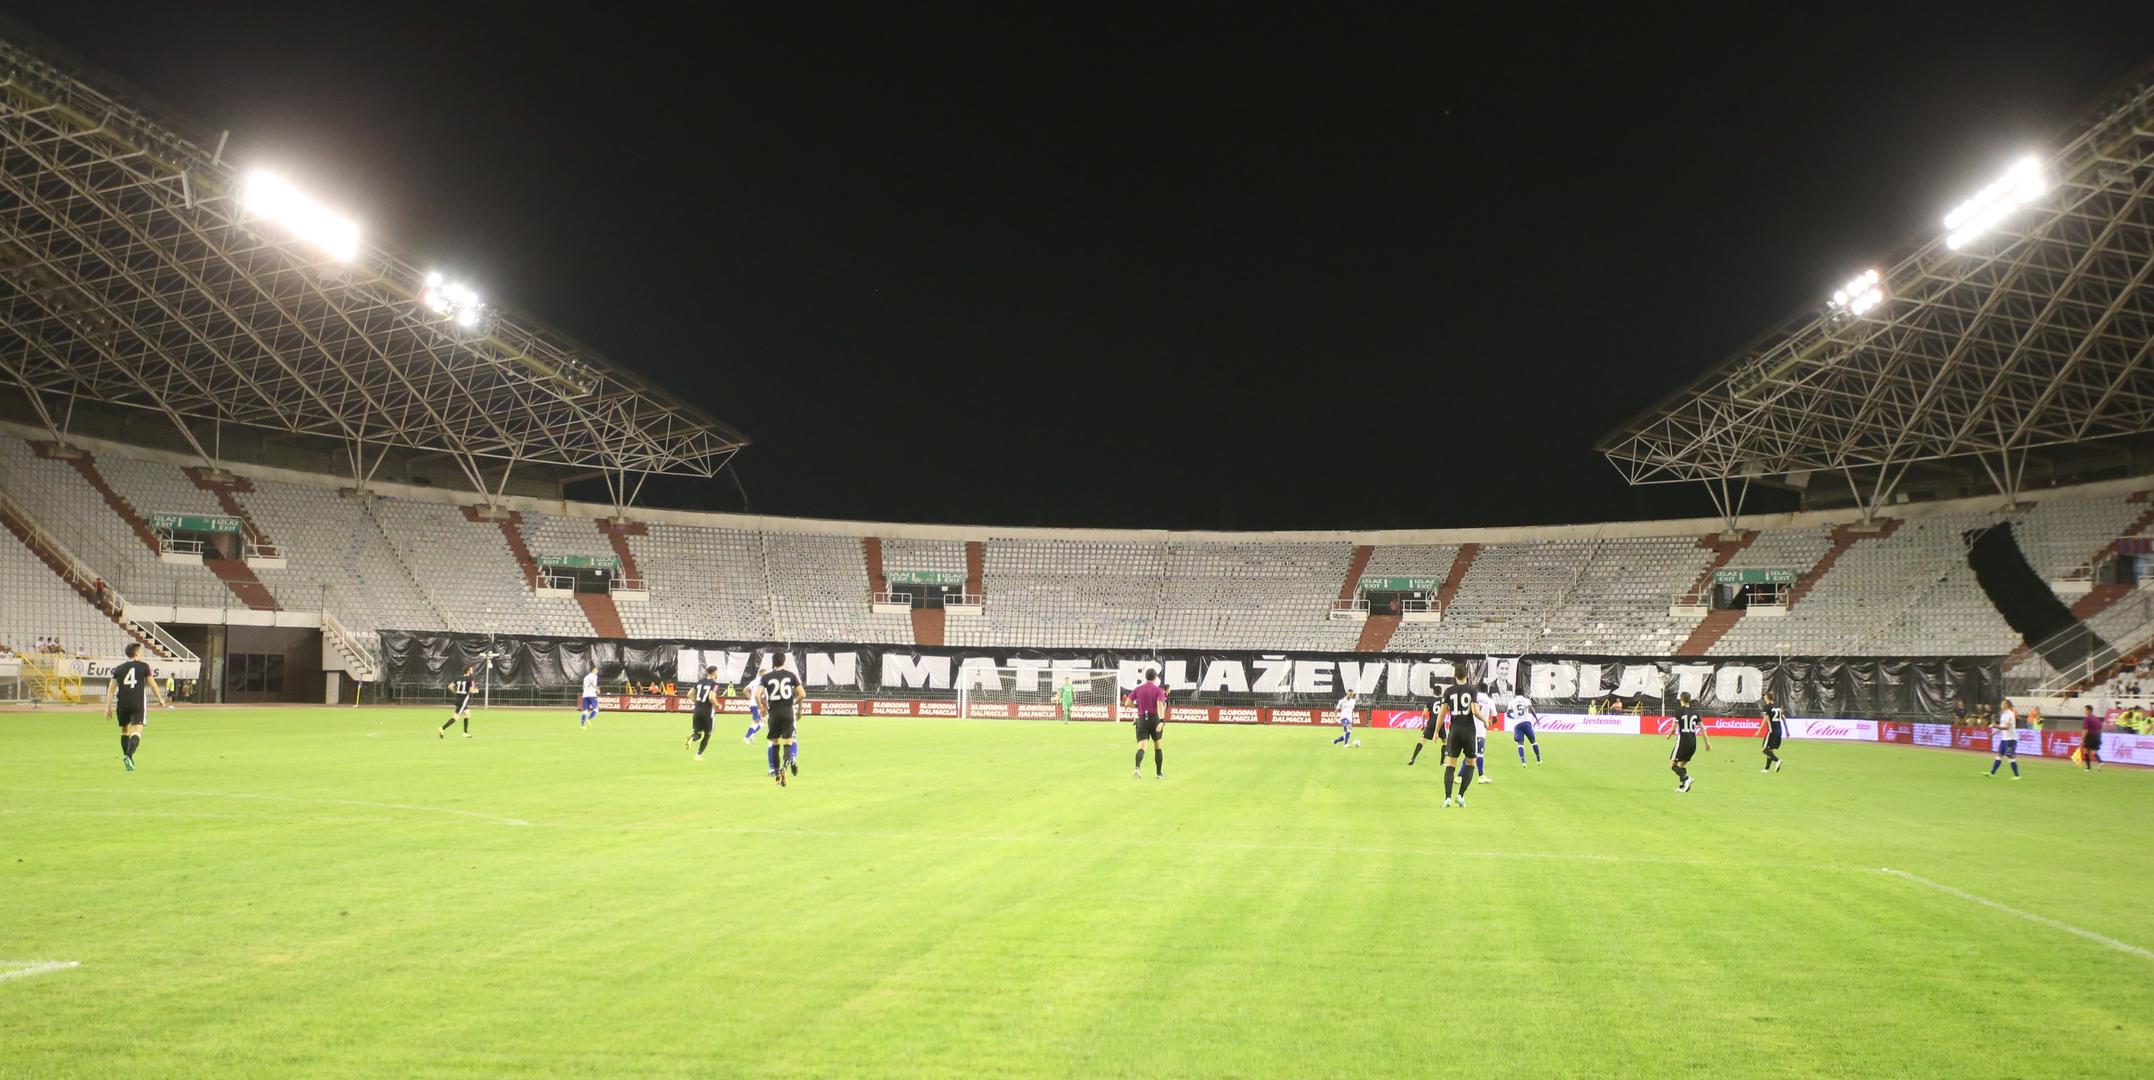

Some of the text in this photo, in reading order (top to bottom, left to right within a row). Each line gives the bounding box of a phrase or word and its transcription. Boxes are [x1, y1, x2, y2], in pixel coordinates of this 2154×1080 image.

[123, 667, 137, 688] 4
[456, 680, 467, 694] 11
[882, 653, 1091, 692] MATE
[1531, 663, 1763, 702] BLATO
[696, 684, 711, 702] 17
[768, 677, 792, 700] 26
[1450, 692, 1472, 715] 19
[1517, 704, 1525, 716] 5
[1681, 714, 1698, 732] 16
